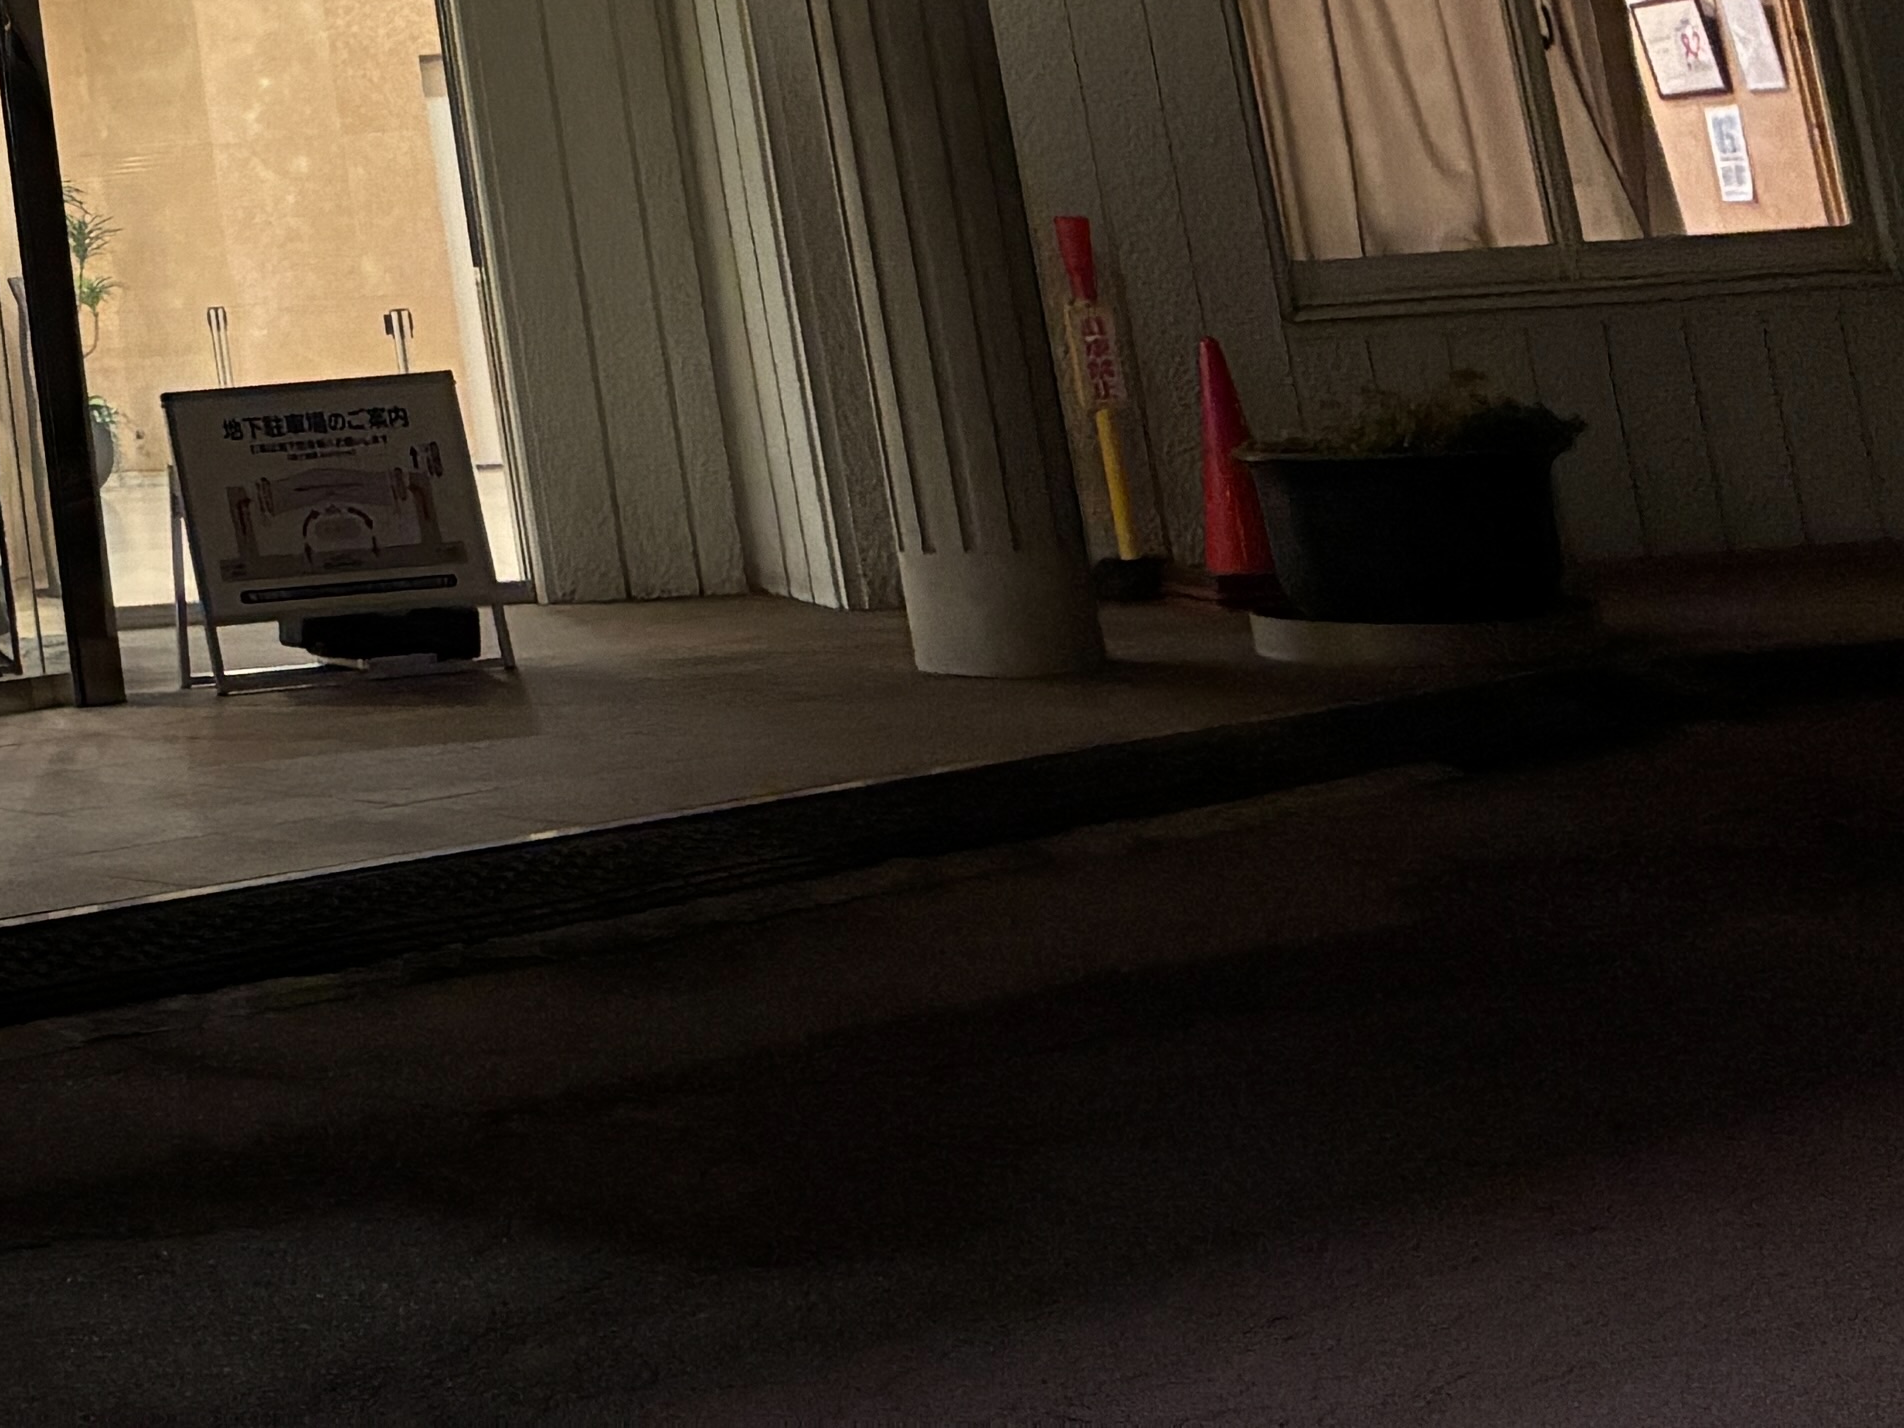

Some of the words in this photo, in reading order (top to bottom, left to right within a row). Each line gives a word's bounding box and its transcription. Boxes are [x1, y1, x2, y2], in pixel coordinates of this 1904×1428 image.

[222, 405, 410, 441] 地下駐車場のご案内
